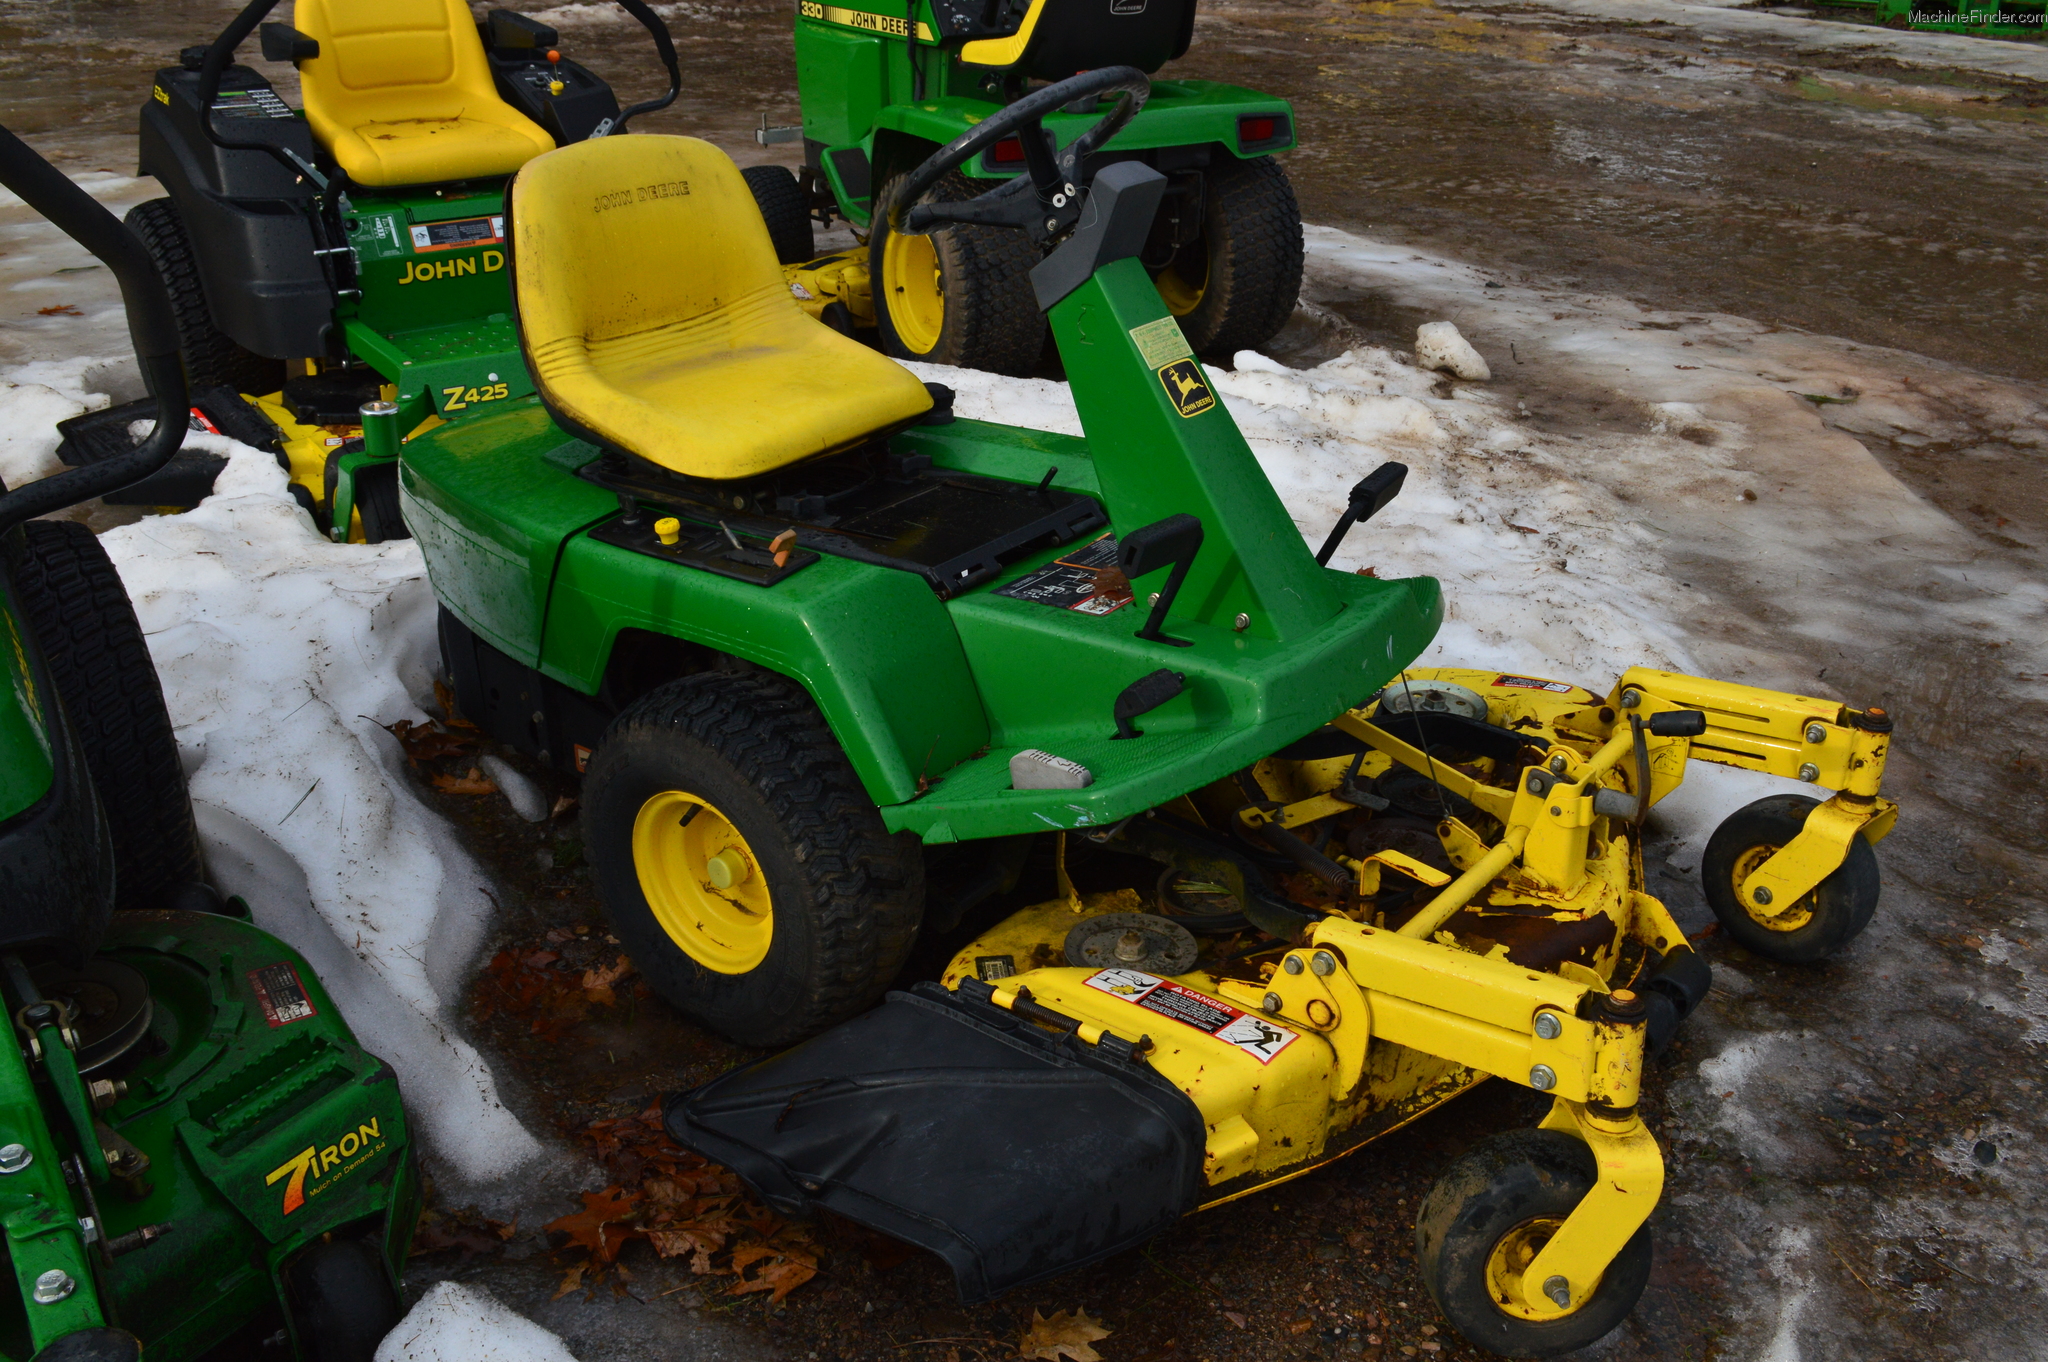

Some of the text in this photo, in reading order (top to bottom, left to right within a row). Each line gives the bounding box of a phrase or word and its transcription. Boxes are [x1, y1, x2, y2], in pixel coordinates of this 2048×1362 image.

[801, 1, 823, 19] 330
[850, 12, 877, 29] JOHN
[594, 181, 690, 213] JOHN DEERE
[398, 256, 477, 285] JOHN
[443, 382, 509, 412] Z425
[1182, 396, 1213, 414] JOHN DEERE
[1183, 989, 1232, 1012] DANGER
[309, 1141, 386, 1197] Mulch on Demand 54
